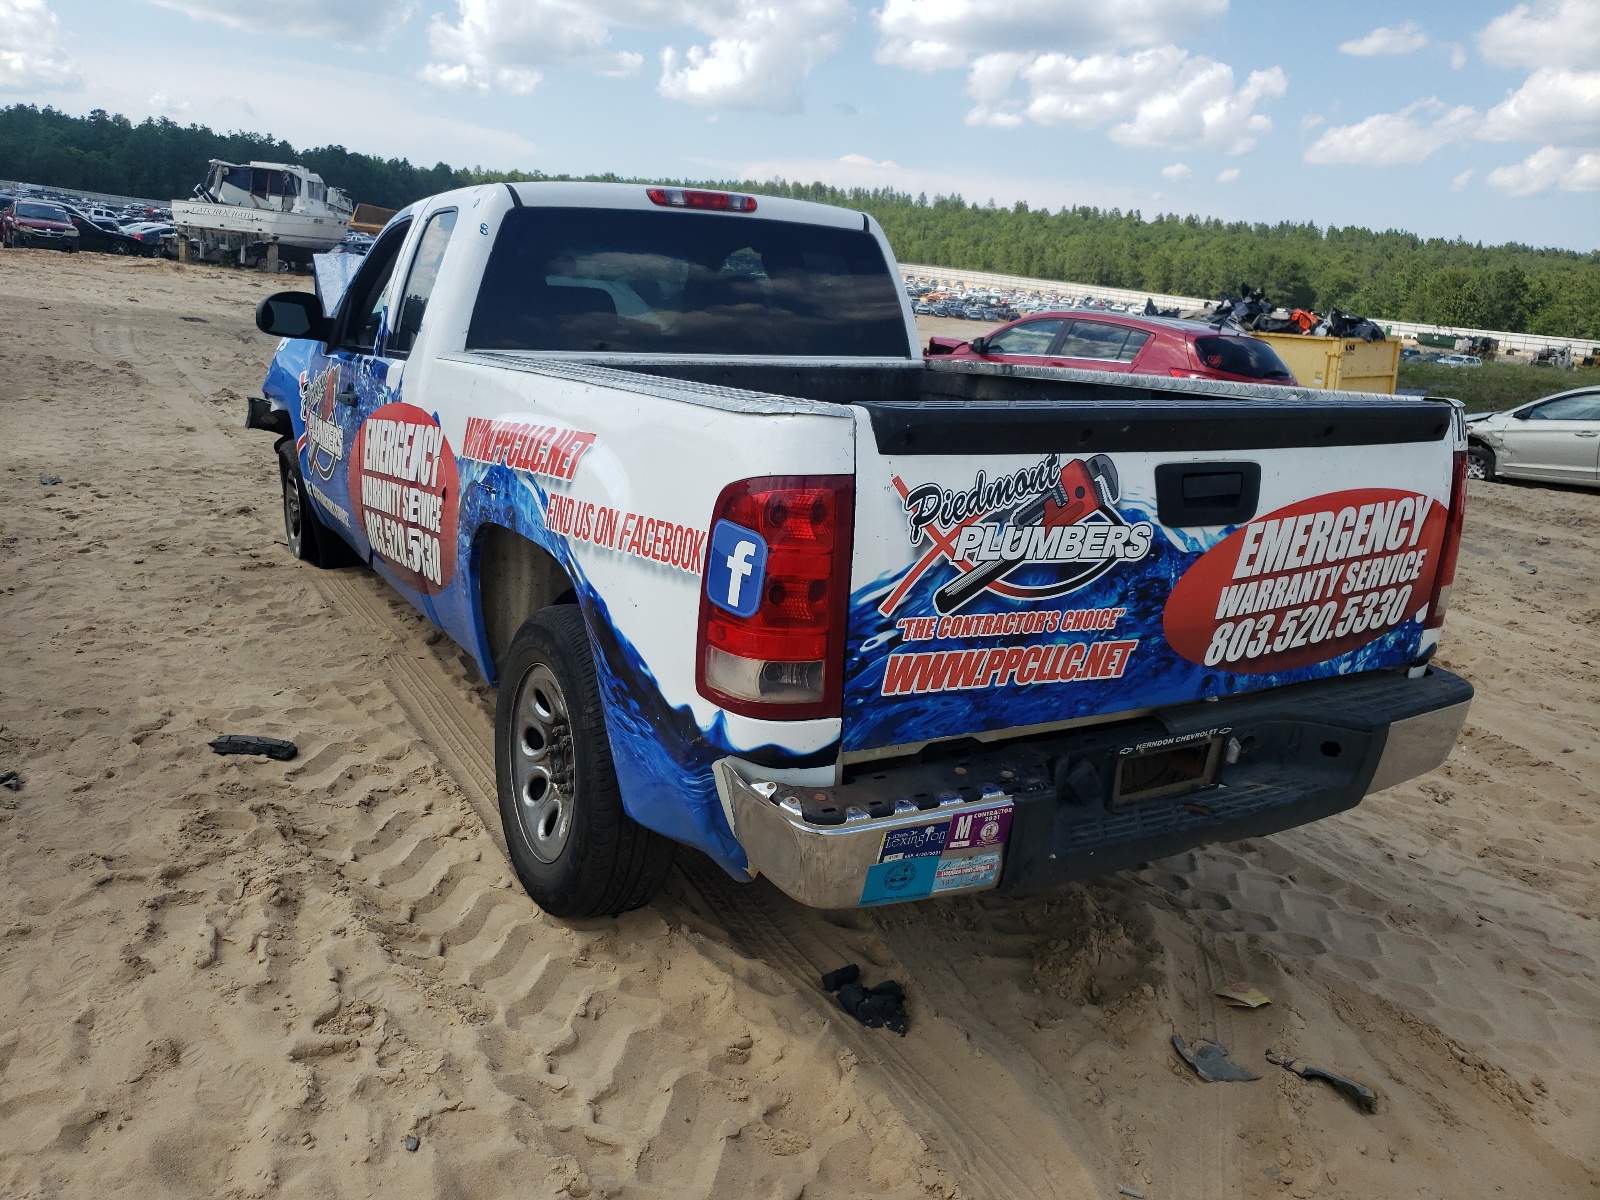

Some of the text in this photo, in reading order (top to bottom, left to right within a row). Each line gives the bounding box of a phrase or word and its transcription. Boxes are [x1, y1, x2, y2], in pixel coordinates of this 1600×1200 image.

[363, 418, 446, 488] EMERGENCY
[462, 416, 596, 482] WWW.PPCLLC.NET
[361, 475, 402, 517] WARRANTY
[402, 488, 443, 533] SERVICE
[903, 454, 1061, 546] Piedmont
[547, 493, 707, 576] FIND US ON FACEBOOK
[952, 524, 1152, 562] PLUMBERS
[1232, 495, 1435, 580] EMERGENCY
[1215, 549, 1428, 620] WARRANTY SERVICE
[937, 612, 1061, 638] CONTRACTOR'S
[1204, 584, 1412, 667] 803.520.5330
[881, 640, 1138, 696] WWW.PPCLLC.NET
[1136, 728, 1219, 751] HERNDON CHEVROLET
[954, 814, 973, 840] M
